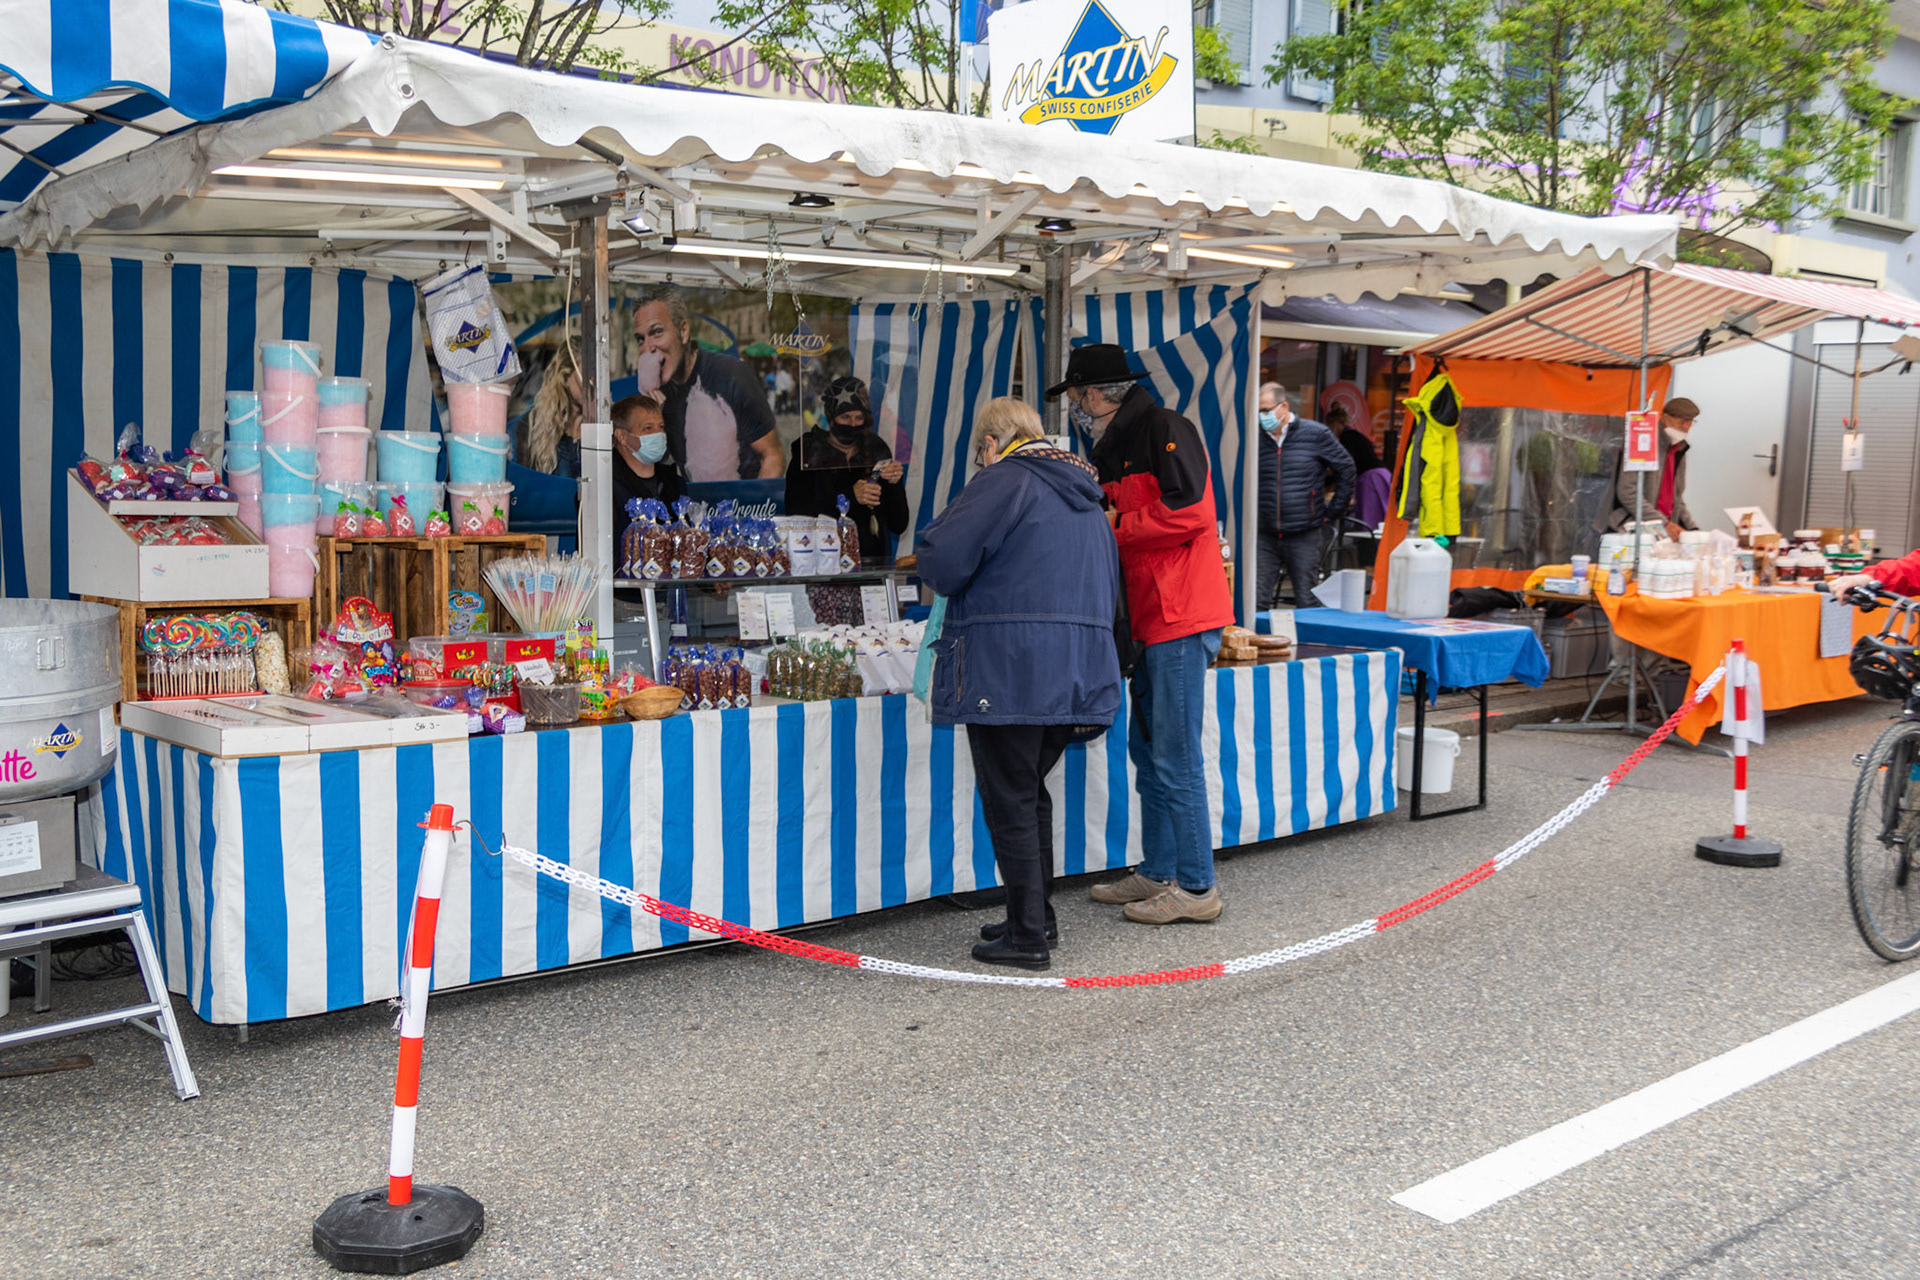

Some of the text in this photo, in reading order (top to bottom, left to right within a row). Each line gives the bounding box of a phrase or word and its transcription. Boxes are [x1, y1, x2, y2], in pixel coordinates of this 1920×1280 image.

[669, 33, 877, 106] KONDITOR
[1002, 25, 1169, 111] MARTIN
[1040, 82, 1153, 118] SWISS CONFISERIE
[768, 333, 830, 350] MARTIN
[26, 728, 82, 748] MARTIN
[0, 749, 37, 783] tte
